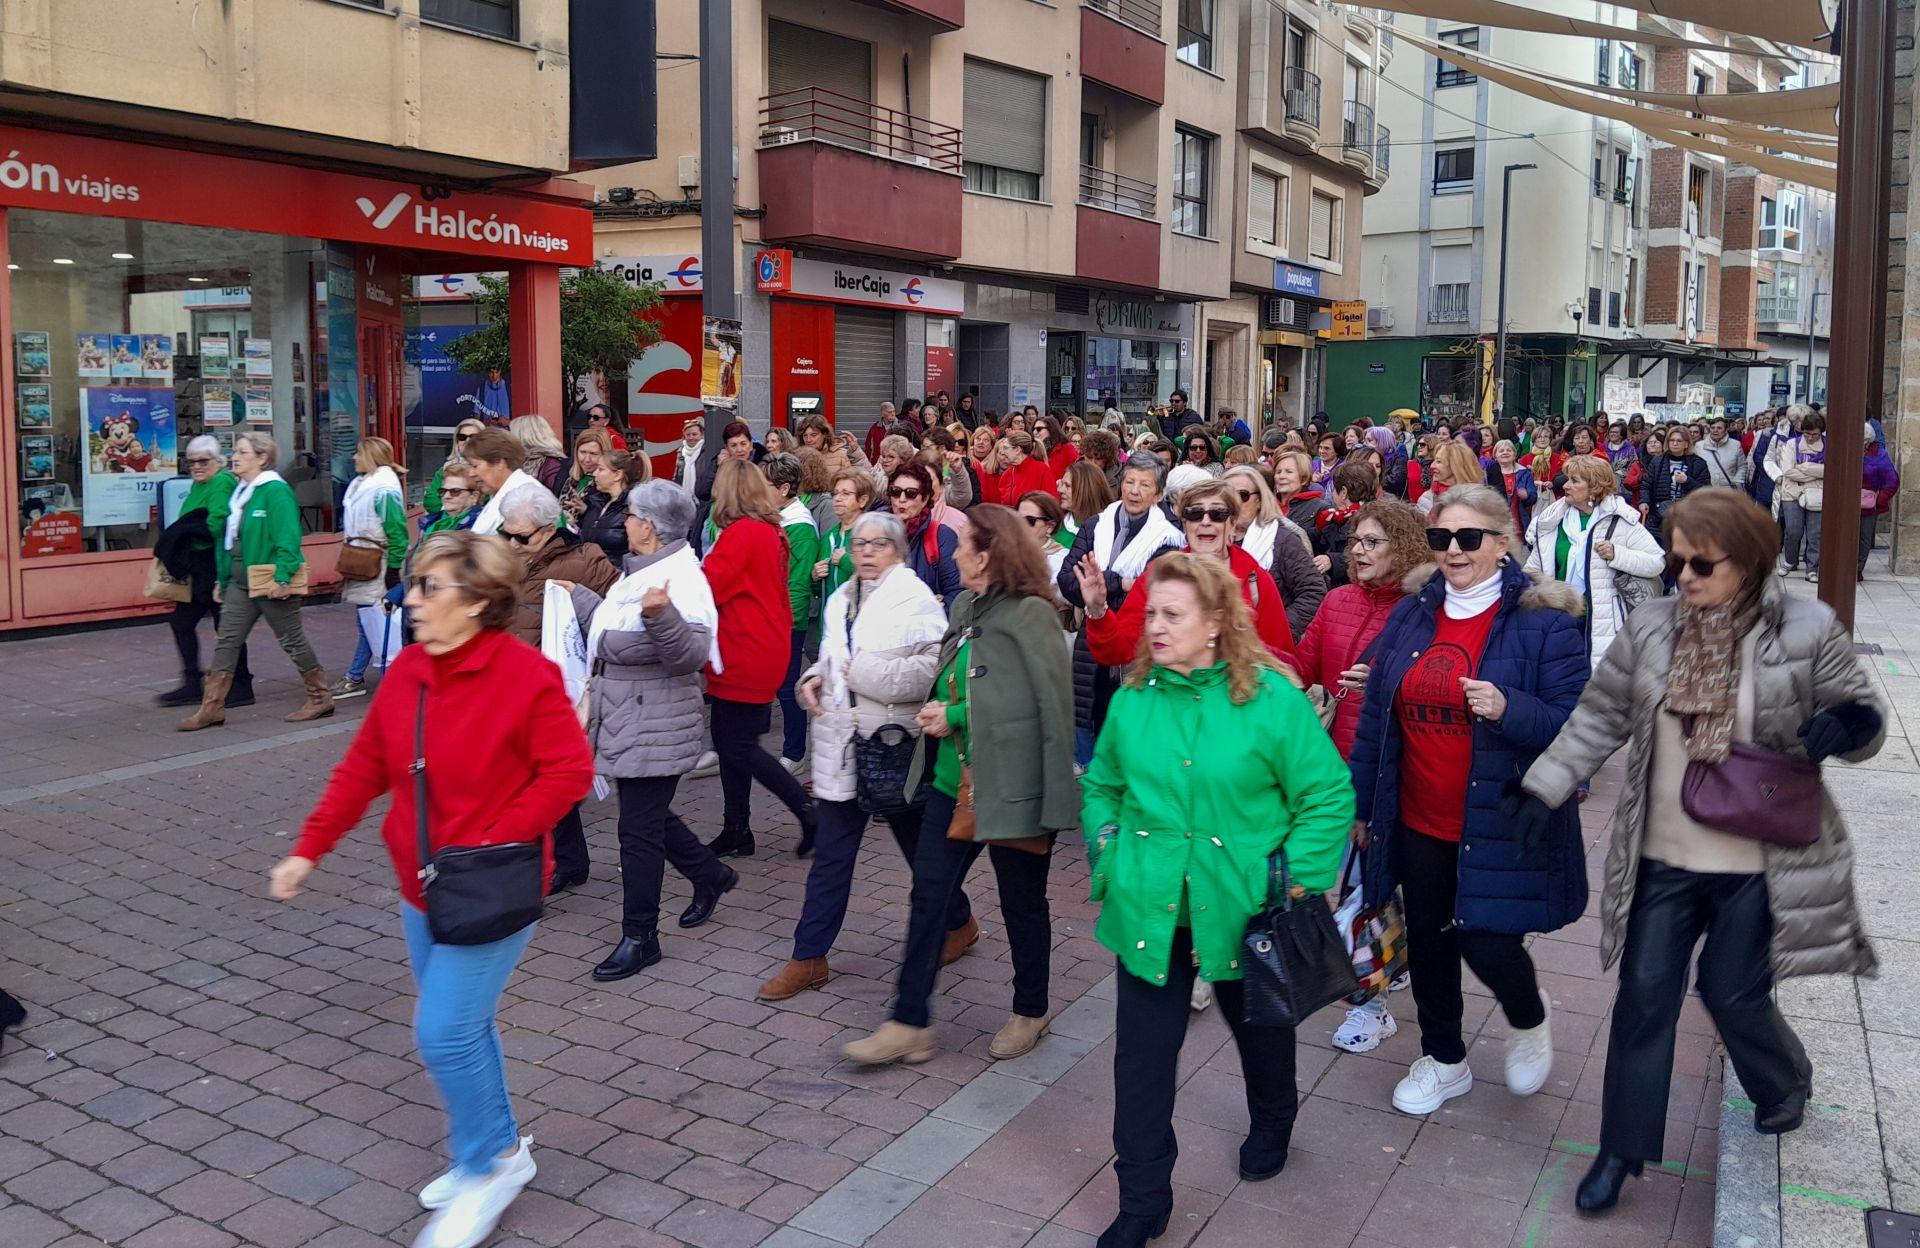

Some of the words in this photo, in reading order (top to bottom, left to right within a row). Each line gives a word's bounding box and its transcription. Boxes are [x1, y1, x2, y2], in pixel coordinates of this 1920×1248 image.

[64, 174, 140, 203] viajes
[415, 204, 521, 246] Halcón
[522, 230, 569, 253] viajes
[834, 270, 890, 297] iberCaja
[1107, 300, 1153, 329] DAMA
[1334, 309, 1363, 322] digital
[1344, 325, 1351, 336] 1
[797, 357, 813, 366] Cajero
